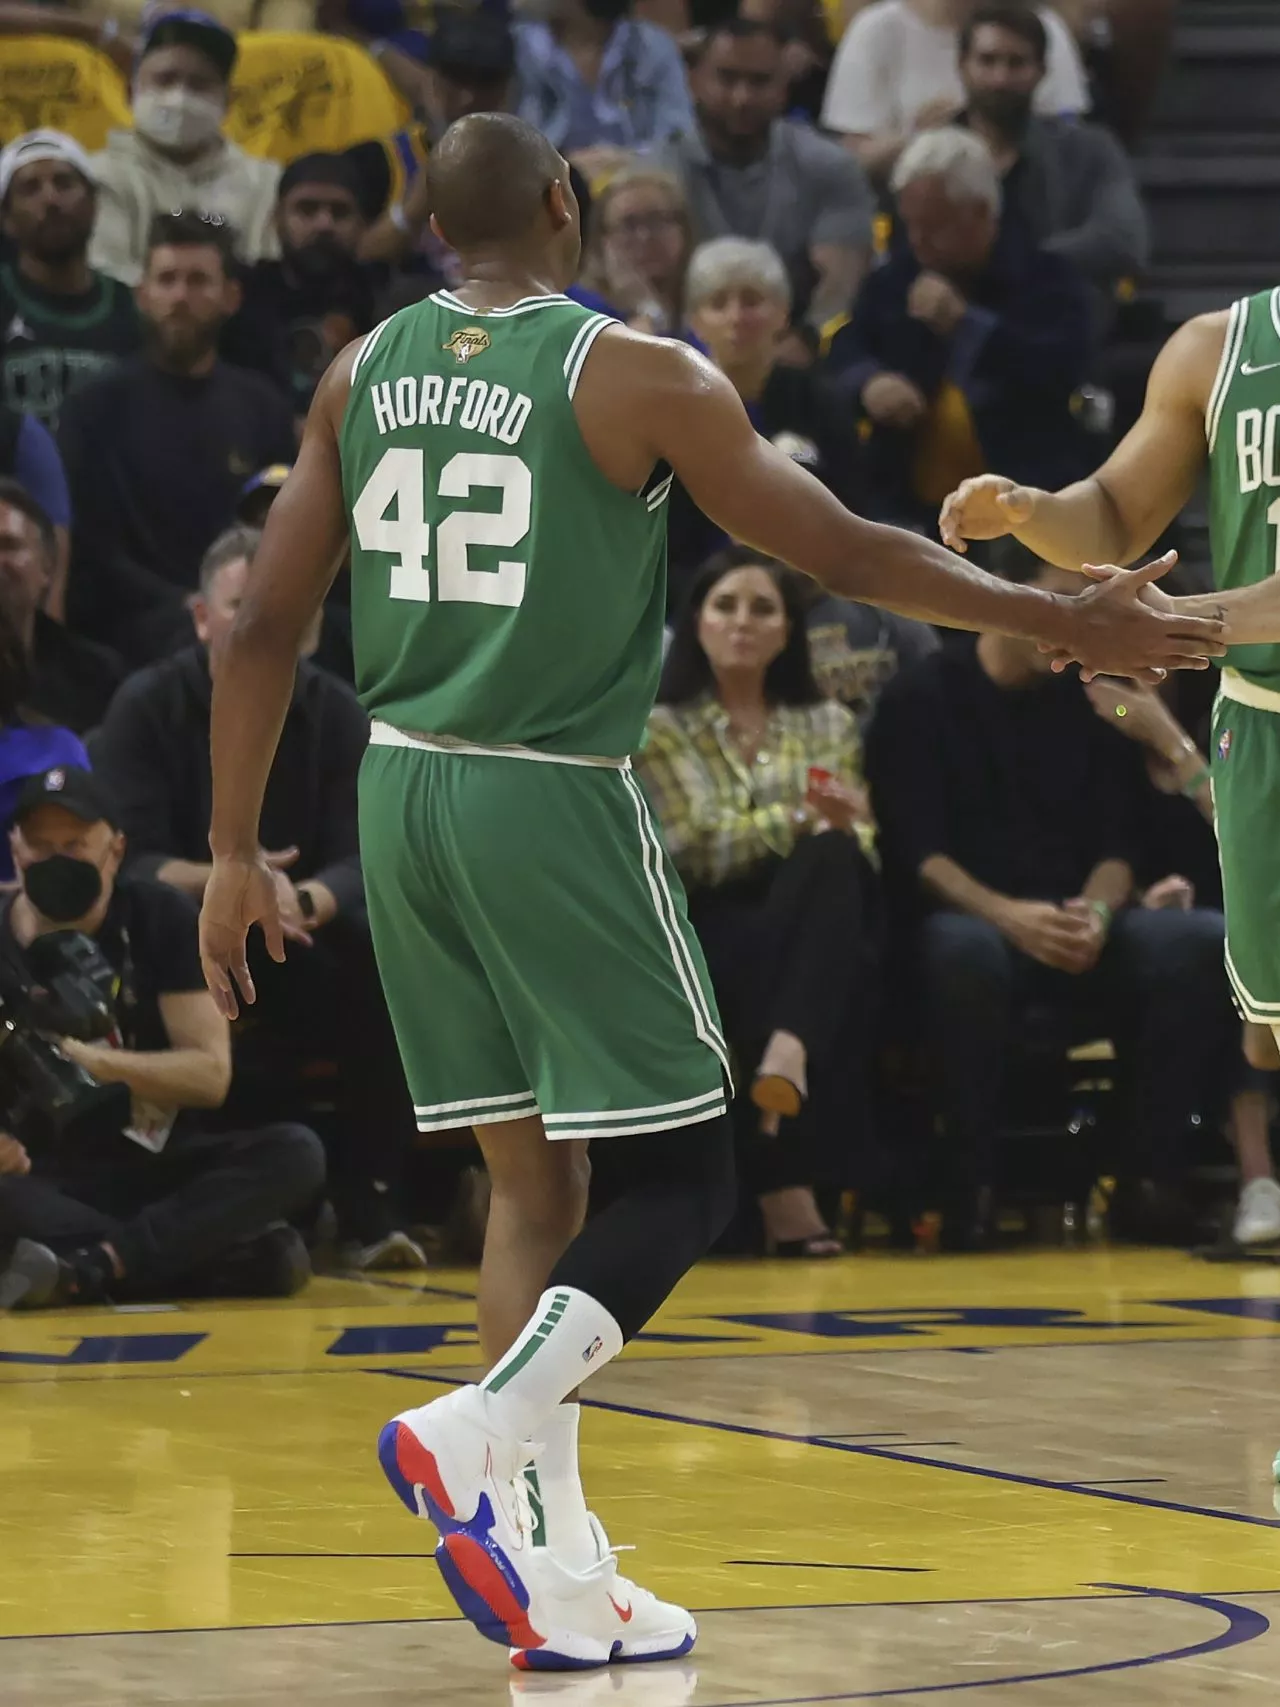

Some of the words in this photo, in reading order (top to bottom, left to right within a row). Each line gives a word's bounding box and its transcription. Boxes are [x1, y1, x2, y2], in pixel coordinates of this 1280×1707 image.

[446, 331, 488, 347] Finals
[371, 375, 533, 446] HORFORD
[352, 447, 532, 608] 42
